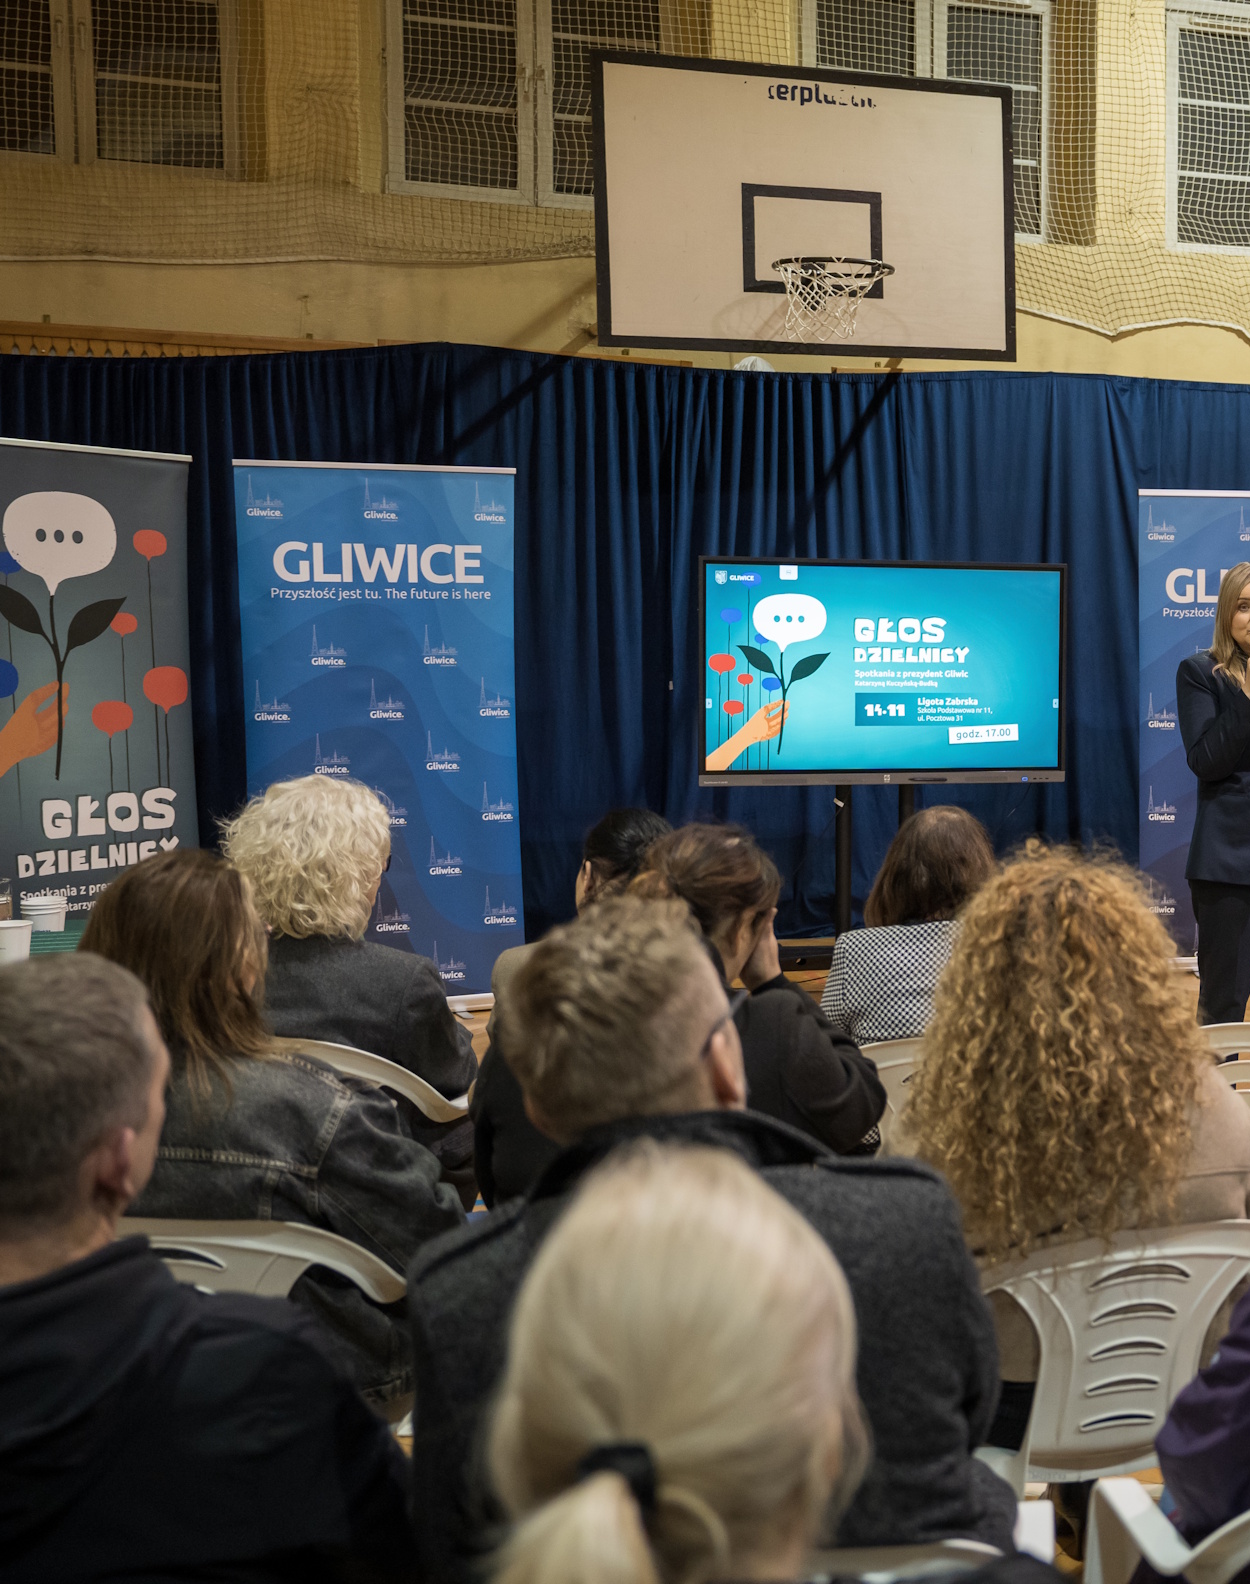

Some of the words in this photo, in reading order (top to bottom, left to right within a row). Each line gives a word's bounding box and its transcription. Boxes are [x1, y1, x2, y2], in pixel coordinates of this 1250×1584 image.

[273, 541, 484, 583] GLIWICE
[271, 588, 336, 602] Przyszłość
[338, 589, 361, 601] jest
[365, 590, 382, 600] tu.
[385, 588, 407, 600] The
[410, 588, 449, 600] future
[452, 589, 462, 600] is
[465, 589, 491, 600] here
[1163, 608, 1214, 620] Przyszłość
[854, 617, 947, 643] GŁOS
[854, 647, 970, 663] DZIELNICY
[854, 670, 895, 678] Spotkania
[902, 670, 943, 679] prezydent
[854, 680, 885, 688] Katarzyną
[917, 698, 944, 707] Ligota
[945, 698, 978, 706] Zabrska
[956, 730, 983, 740] godz.
[985, 728, 1011, 738] 17.00
[42, 787, 177, 840] GŁOS
[79, 885, 86, 895] z
